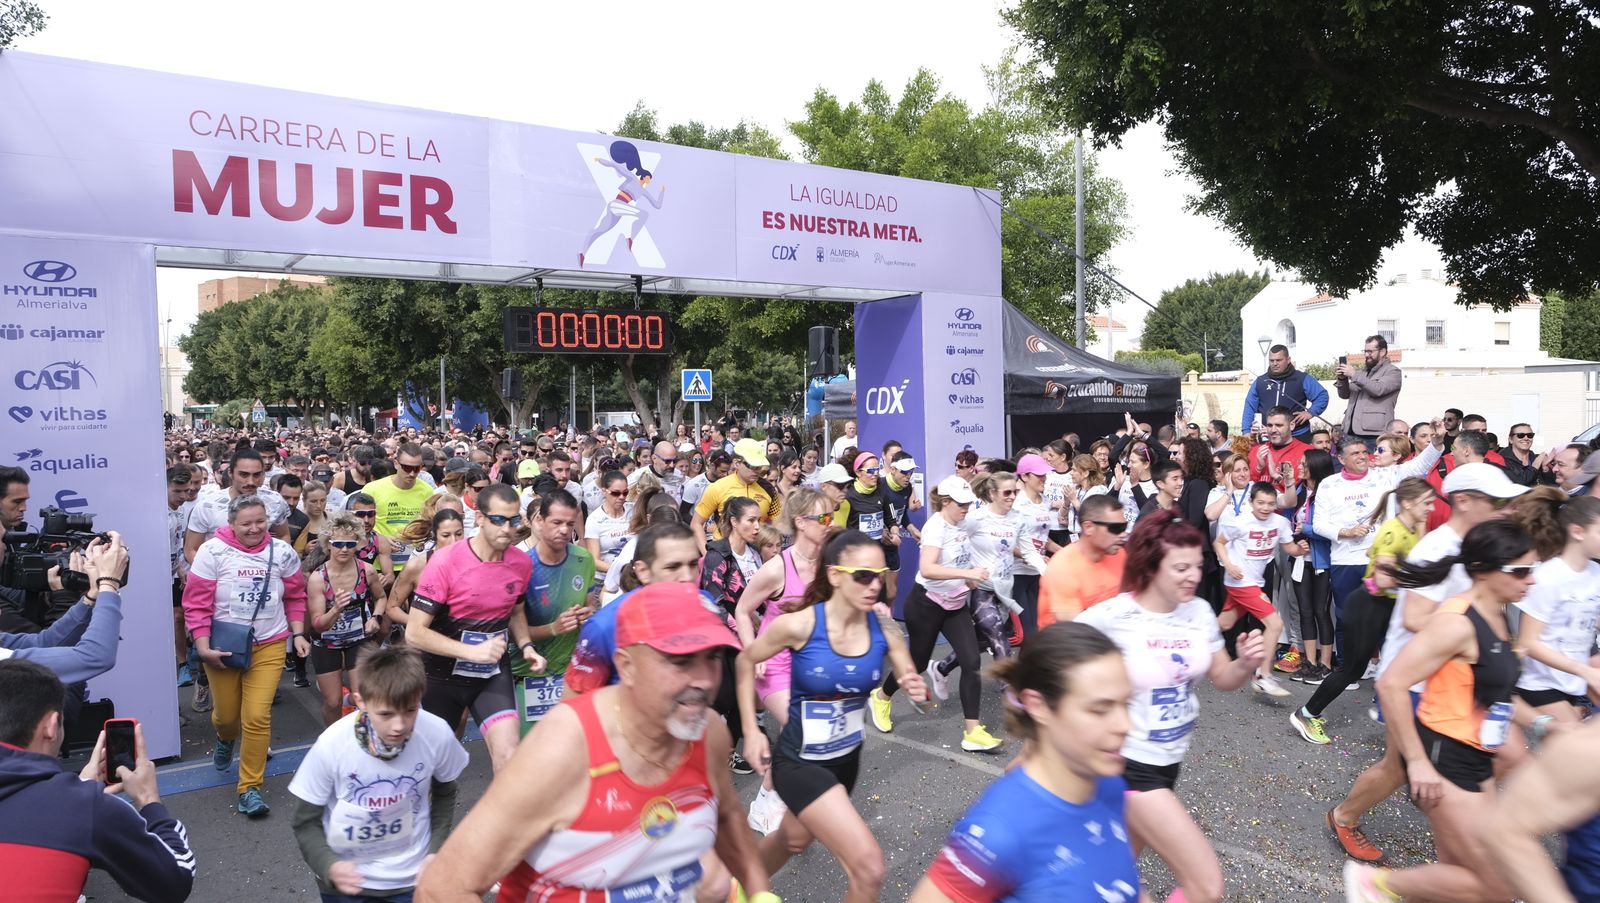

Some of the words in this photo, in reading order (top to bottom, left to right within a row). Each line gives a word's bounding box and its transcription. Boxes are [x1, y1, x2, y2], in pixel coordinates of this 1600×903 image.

[189, 110, 347, 152] CARRERA
[357, 131, 395, 158] DE
[406, 137, 441, 163] LA
[172, 149, 458, 235] MUJER
[790, 184, 811, 203] LA
[816, 187, 898, 213] IGUALDAD
[762, 210, 786, 230] ES
[790, 213, 870, 238] NUESTRA
[873, 222, 922, 243] META.
[771, 243, 800, 261] CDX
[830, 248, 859, 259] ALMERÍA
[4, 285, 97, 298] HYUNDAI
[17, 299, 88, 310] Almerialva
[537, 312, 663, 349] 00:00:00
[947, 322, 982, 330] HYUNDAI
[30, 326, 105, 342] cajamar
[957, 346, 984, 356] cajamar
[14, 369, 81, 391] CASI
[951, 372, 976, 385] CASI
[865, 379, 910, 415] CDX
[959, 395, 984, 404] vithas
[40, 406, 107, 421] vithas
[955, 423, 984, 435] aqualia
[30, 453, 109, 475] aqualia
[238, 592, 272, 603] 1335
[537, 687, 563, 701] 376
[344, 819, 403, 841] 1336
